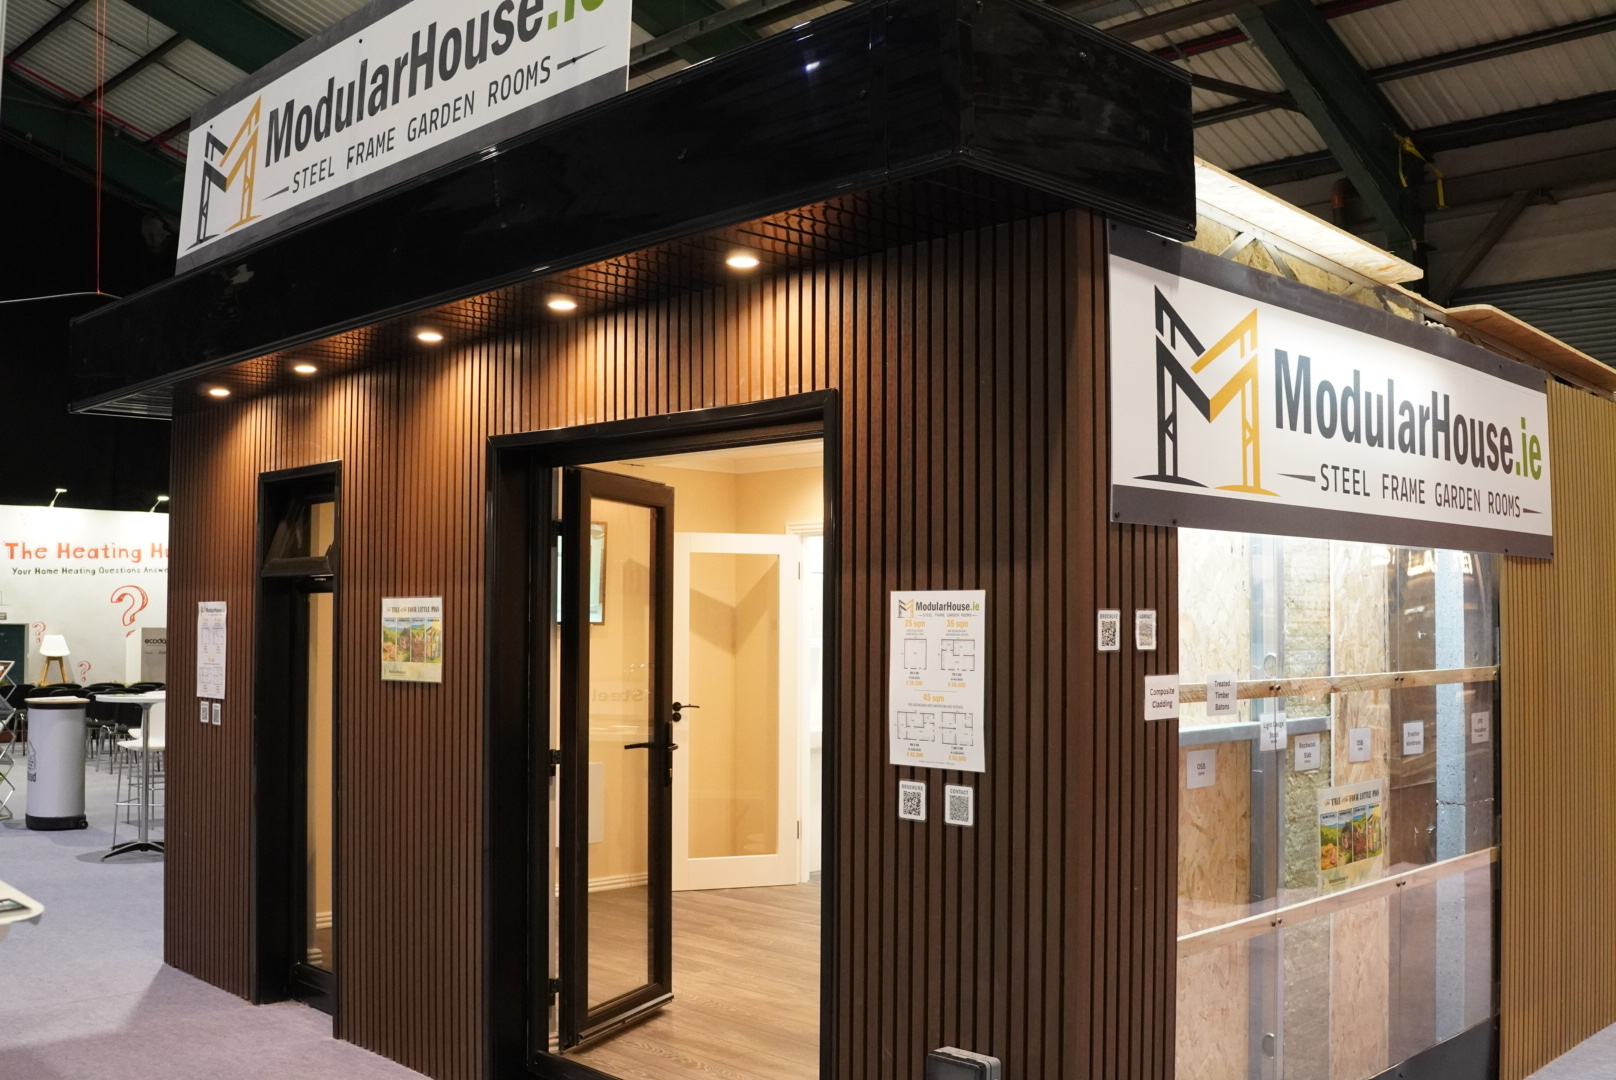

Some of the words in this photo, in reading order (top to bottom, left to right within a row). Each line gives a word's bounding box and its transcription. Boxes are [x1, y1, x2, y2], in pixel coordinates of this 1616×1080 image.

[264, 0, 604, 168] ModularHouse.
[292, 156, 335, 194] STEEL
[346, 127, 396, 170] FRAME
[407, 90, 475, 142] GARDEN
[487, 56, 551, 107] ROOMS
[1274, 348, 1542, 481] ModularHouse.ie
[1320, 464, 1371, 498] STEEL
[1382, 473, 1426, 505] FRAME
[1434, 481, 1481, 513] GARDEN
[1488, 491, 1521, 519] ROOMS
[5, 542, 47, 560] The
[57, 542, 141, 564] Heating
[150, 542, 168, 559] H
[12, 567, 31, 576] Your
[34, 567, 59, 575] Home
[62, 567, 96, 576] Heating
[98, 566, 141, 574] Questions
[915, 601, 980, 611] ModularHouse.ie
[914, 620, 926, 628] sqm
[956, 621, 969, 629] sqm
[1150, 688, 1175, 696] Composite
[923, 694, 931, 702] 45
[932, 695, 945, 703] sqm
[1152, 700, 1173, 709] Cladding
[1215, 703, 1230, 711] Batons
[1360, 790, 1372, 800] LITTLE
